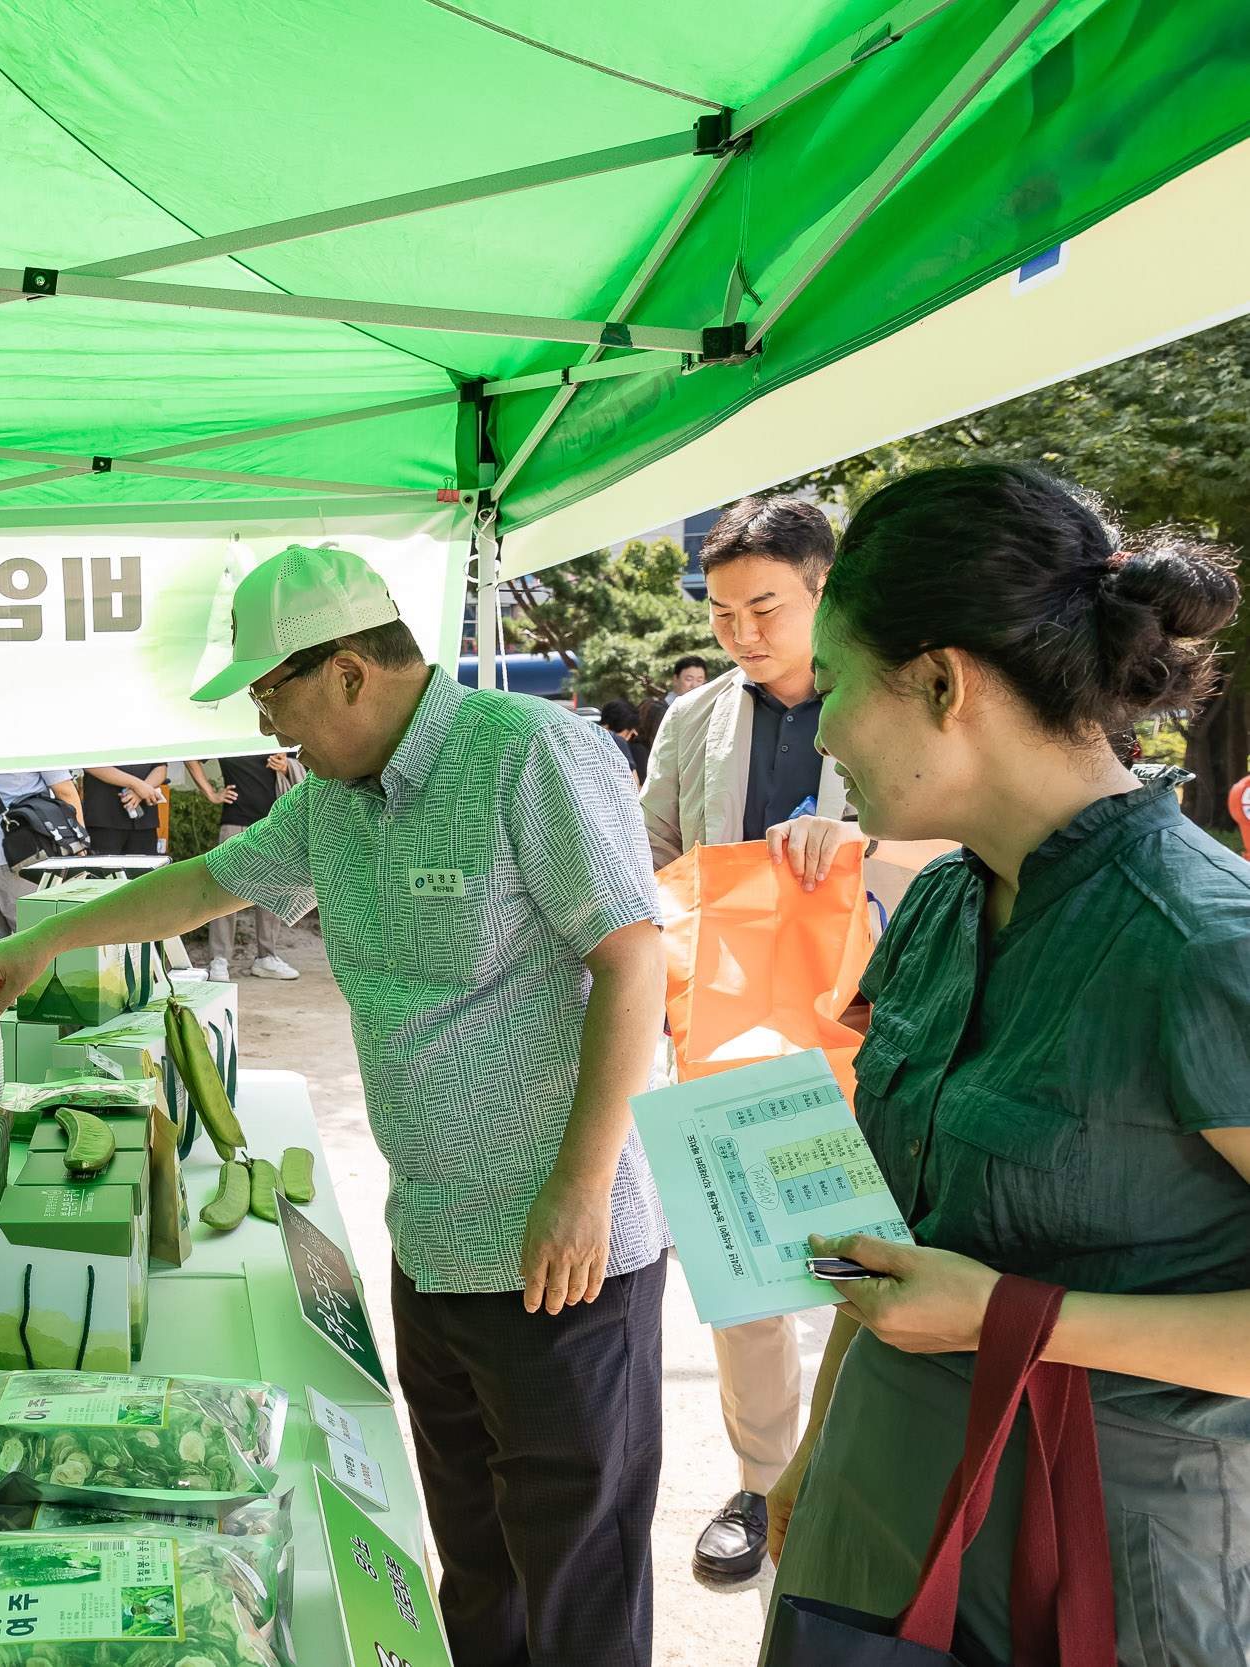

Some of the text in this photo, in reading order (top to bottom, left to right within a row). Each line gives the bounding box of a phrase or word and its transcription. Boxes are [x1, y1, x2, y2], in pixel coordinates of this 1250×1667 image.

[426, 873, 458, 884] 김경호
[686, 1134, 700, 1155] 배치도
[694, 1156, 712, 1188] 직거래장터
[717, 1224, 734, 1250] 추석맞이
[728, 1252, 743, 1276] 2024년
[299, 1243, 366, 1352] 작두콩차
[23, 1398, 53, 1421] 여주
[382, 1551, 420, 1632] 피로회복
[6, 1593, 39, 1637] 여주
